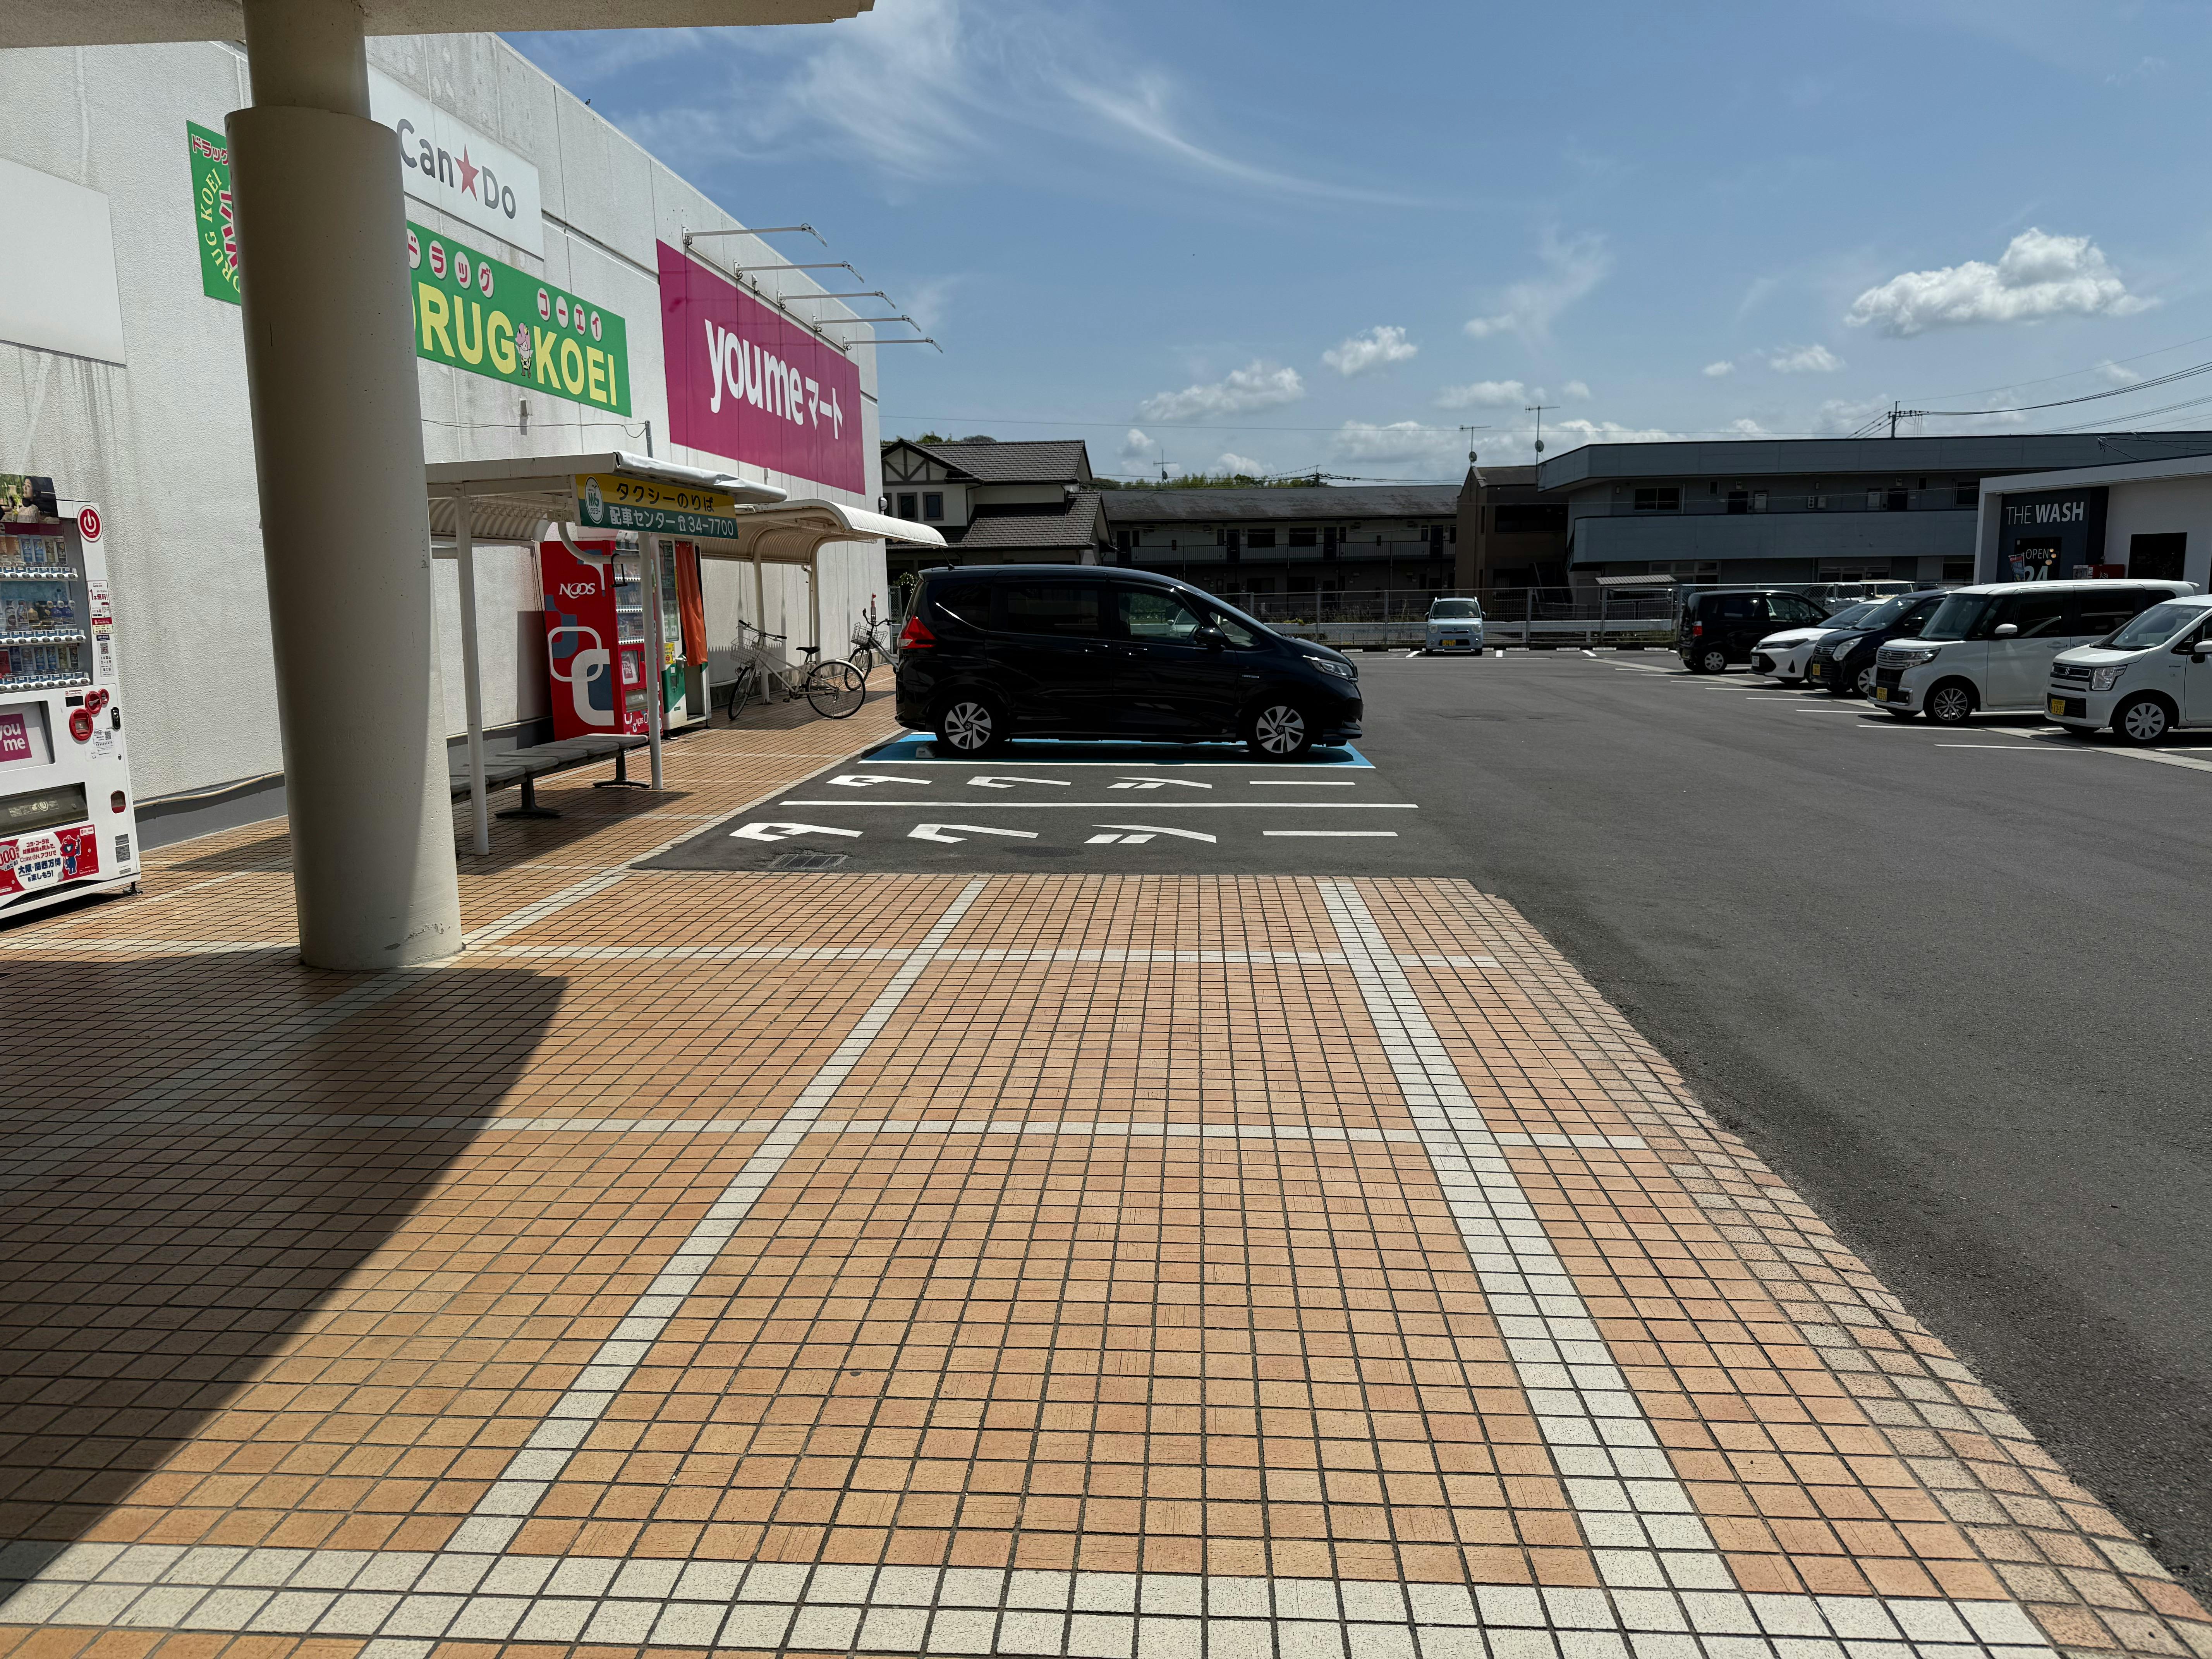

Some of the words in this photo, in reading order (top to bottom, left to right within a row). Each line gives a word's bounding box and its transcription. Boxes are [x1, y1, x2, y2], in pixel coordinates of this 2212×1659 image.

[201, 167, 222, 223] KOEI
[539, 292, 599, 337] コーエイ
[412, 282, 516, 374] RUG
[533, 325, 617, 406] KOEI
[609, 506, 675, 529] 配車センター
[689, 515, 733, 536] 34-7700
[2006, 505, 2032, 525] THE
[2035, 501, 2084, 523] WASH
[2026, 548, 2049, 559] OPEN
[3, 738, 26, 751] me
